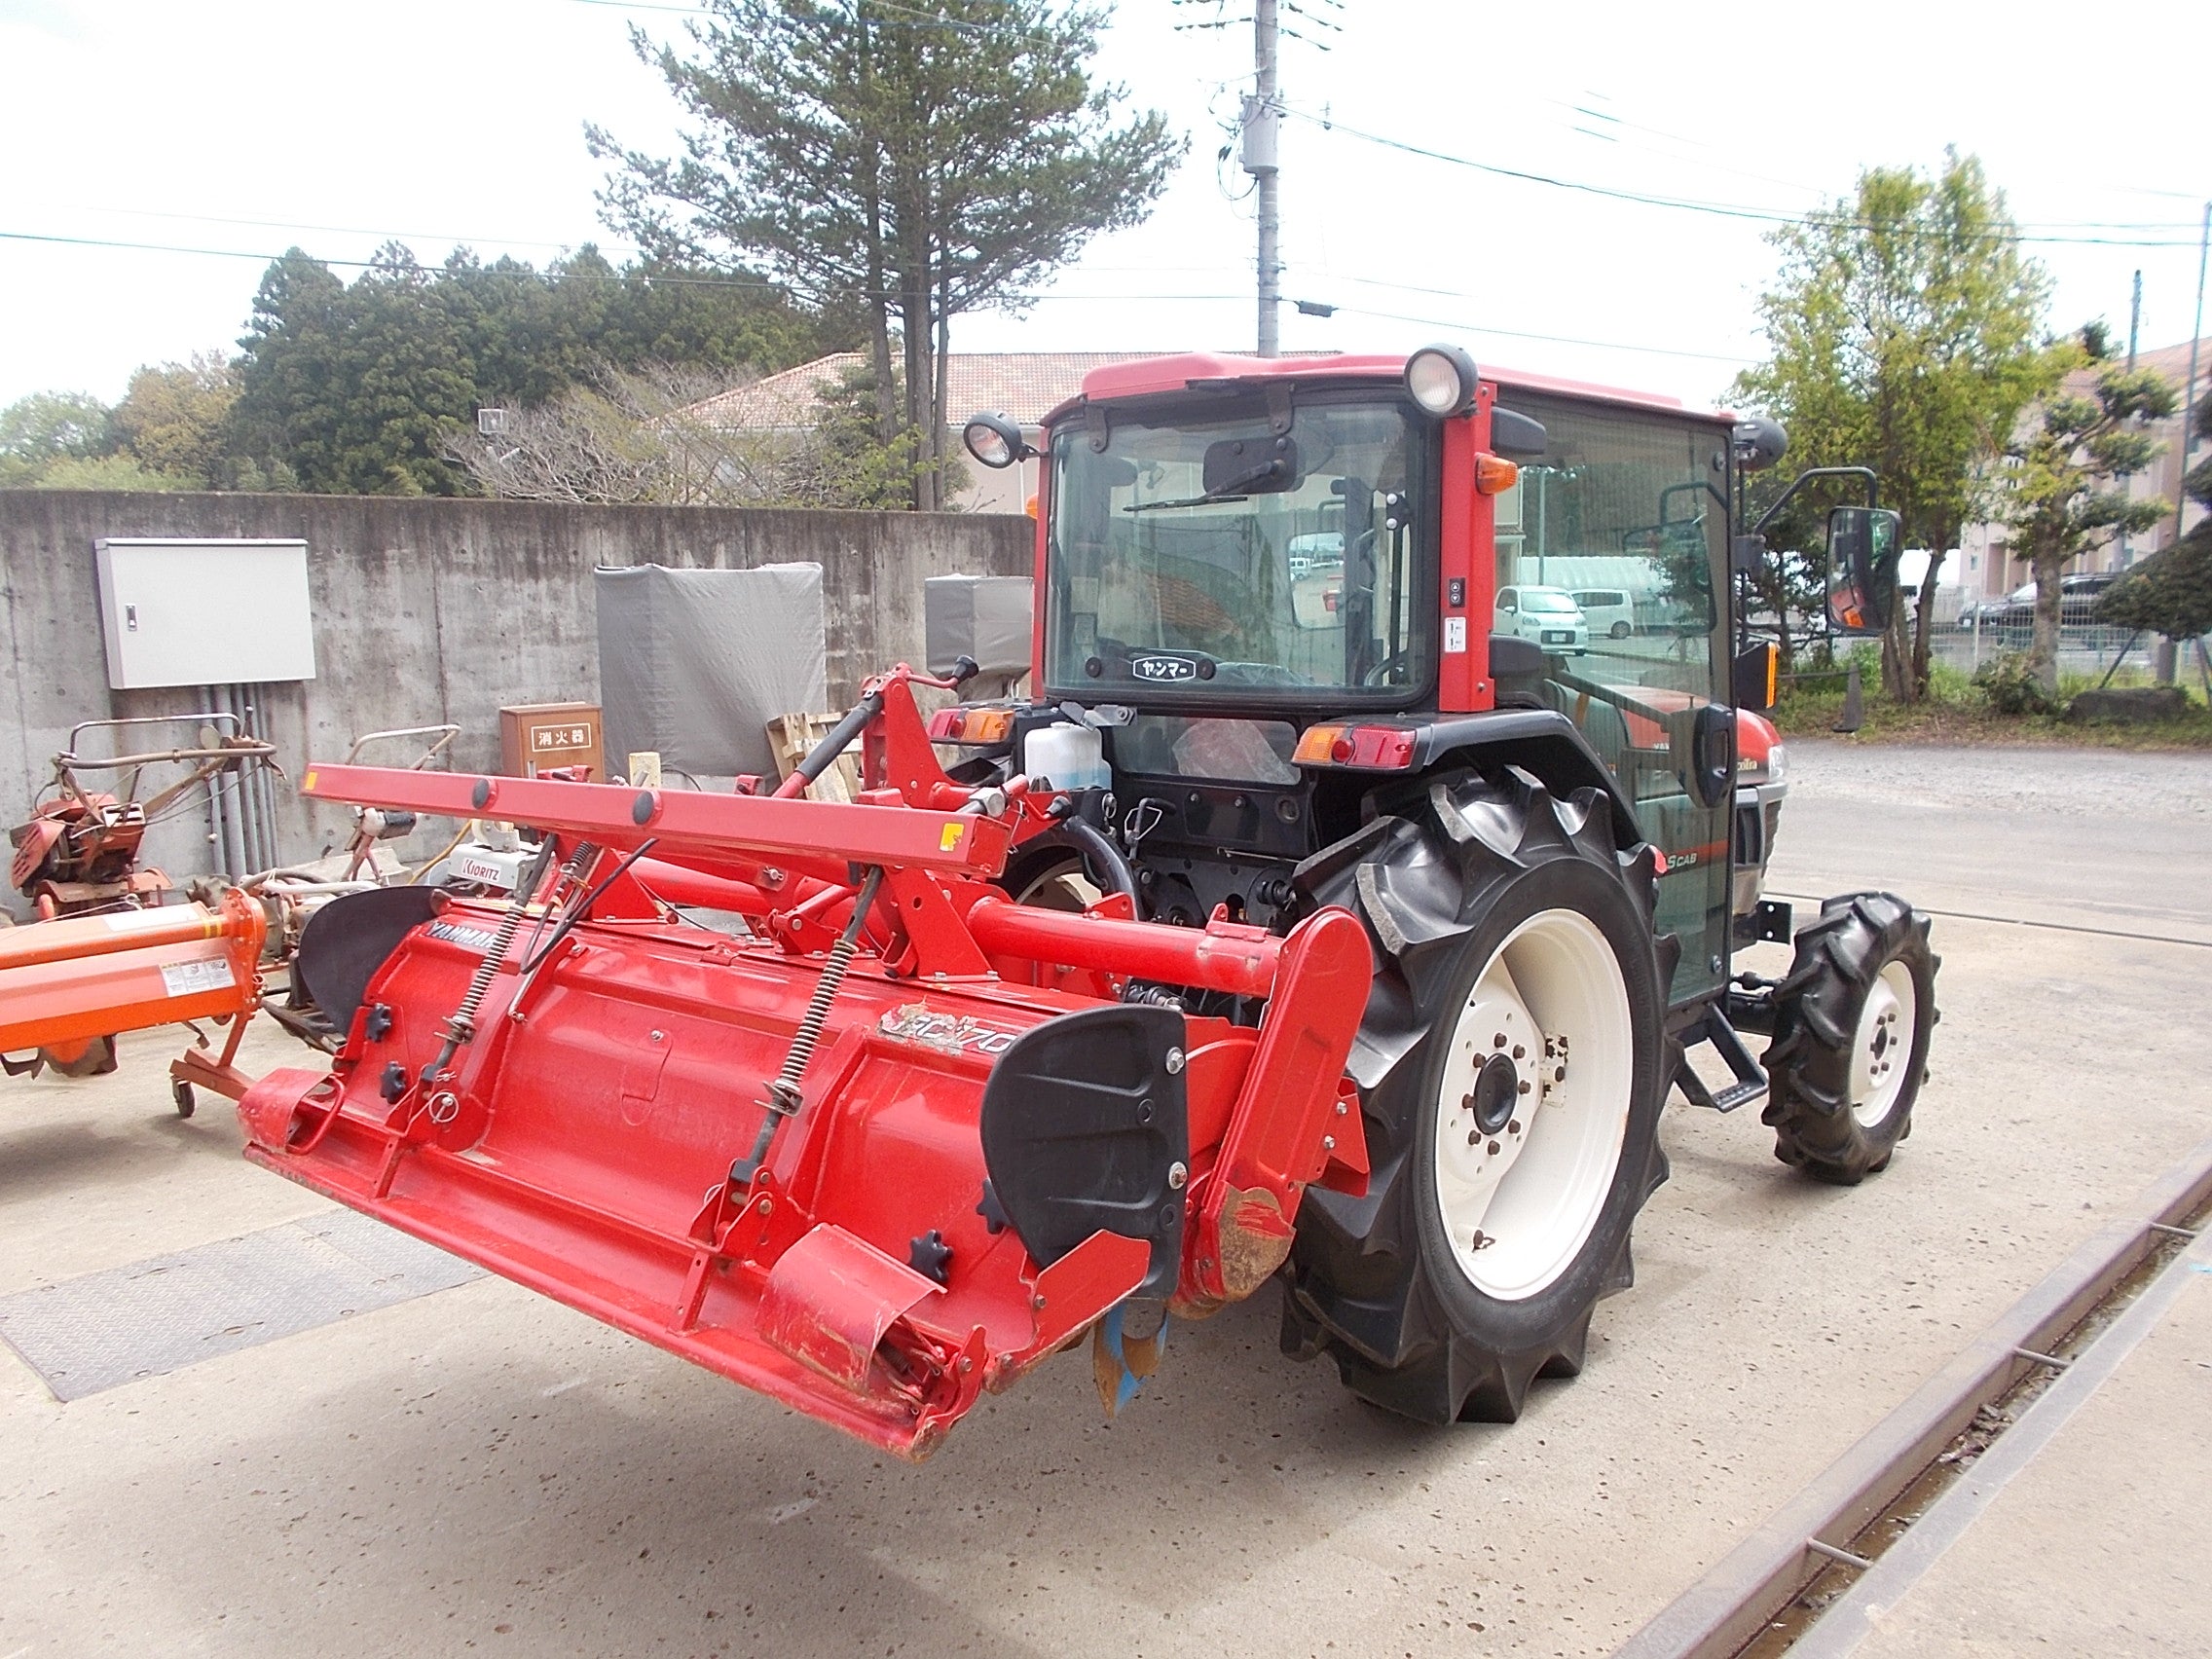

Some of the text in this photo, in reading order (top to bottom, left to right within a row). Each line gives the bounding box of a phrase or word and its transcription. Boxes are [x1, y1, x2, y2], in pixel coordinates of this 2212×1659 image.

[1142, 660, 1188, 678] ヤンマー
[538, 729, 585, 746] 消火器
[462, 858, 500, 881] KIORITZ
